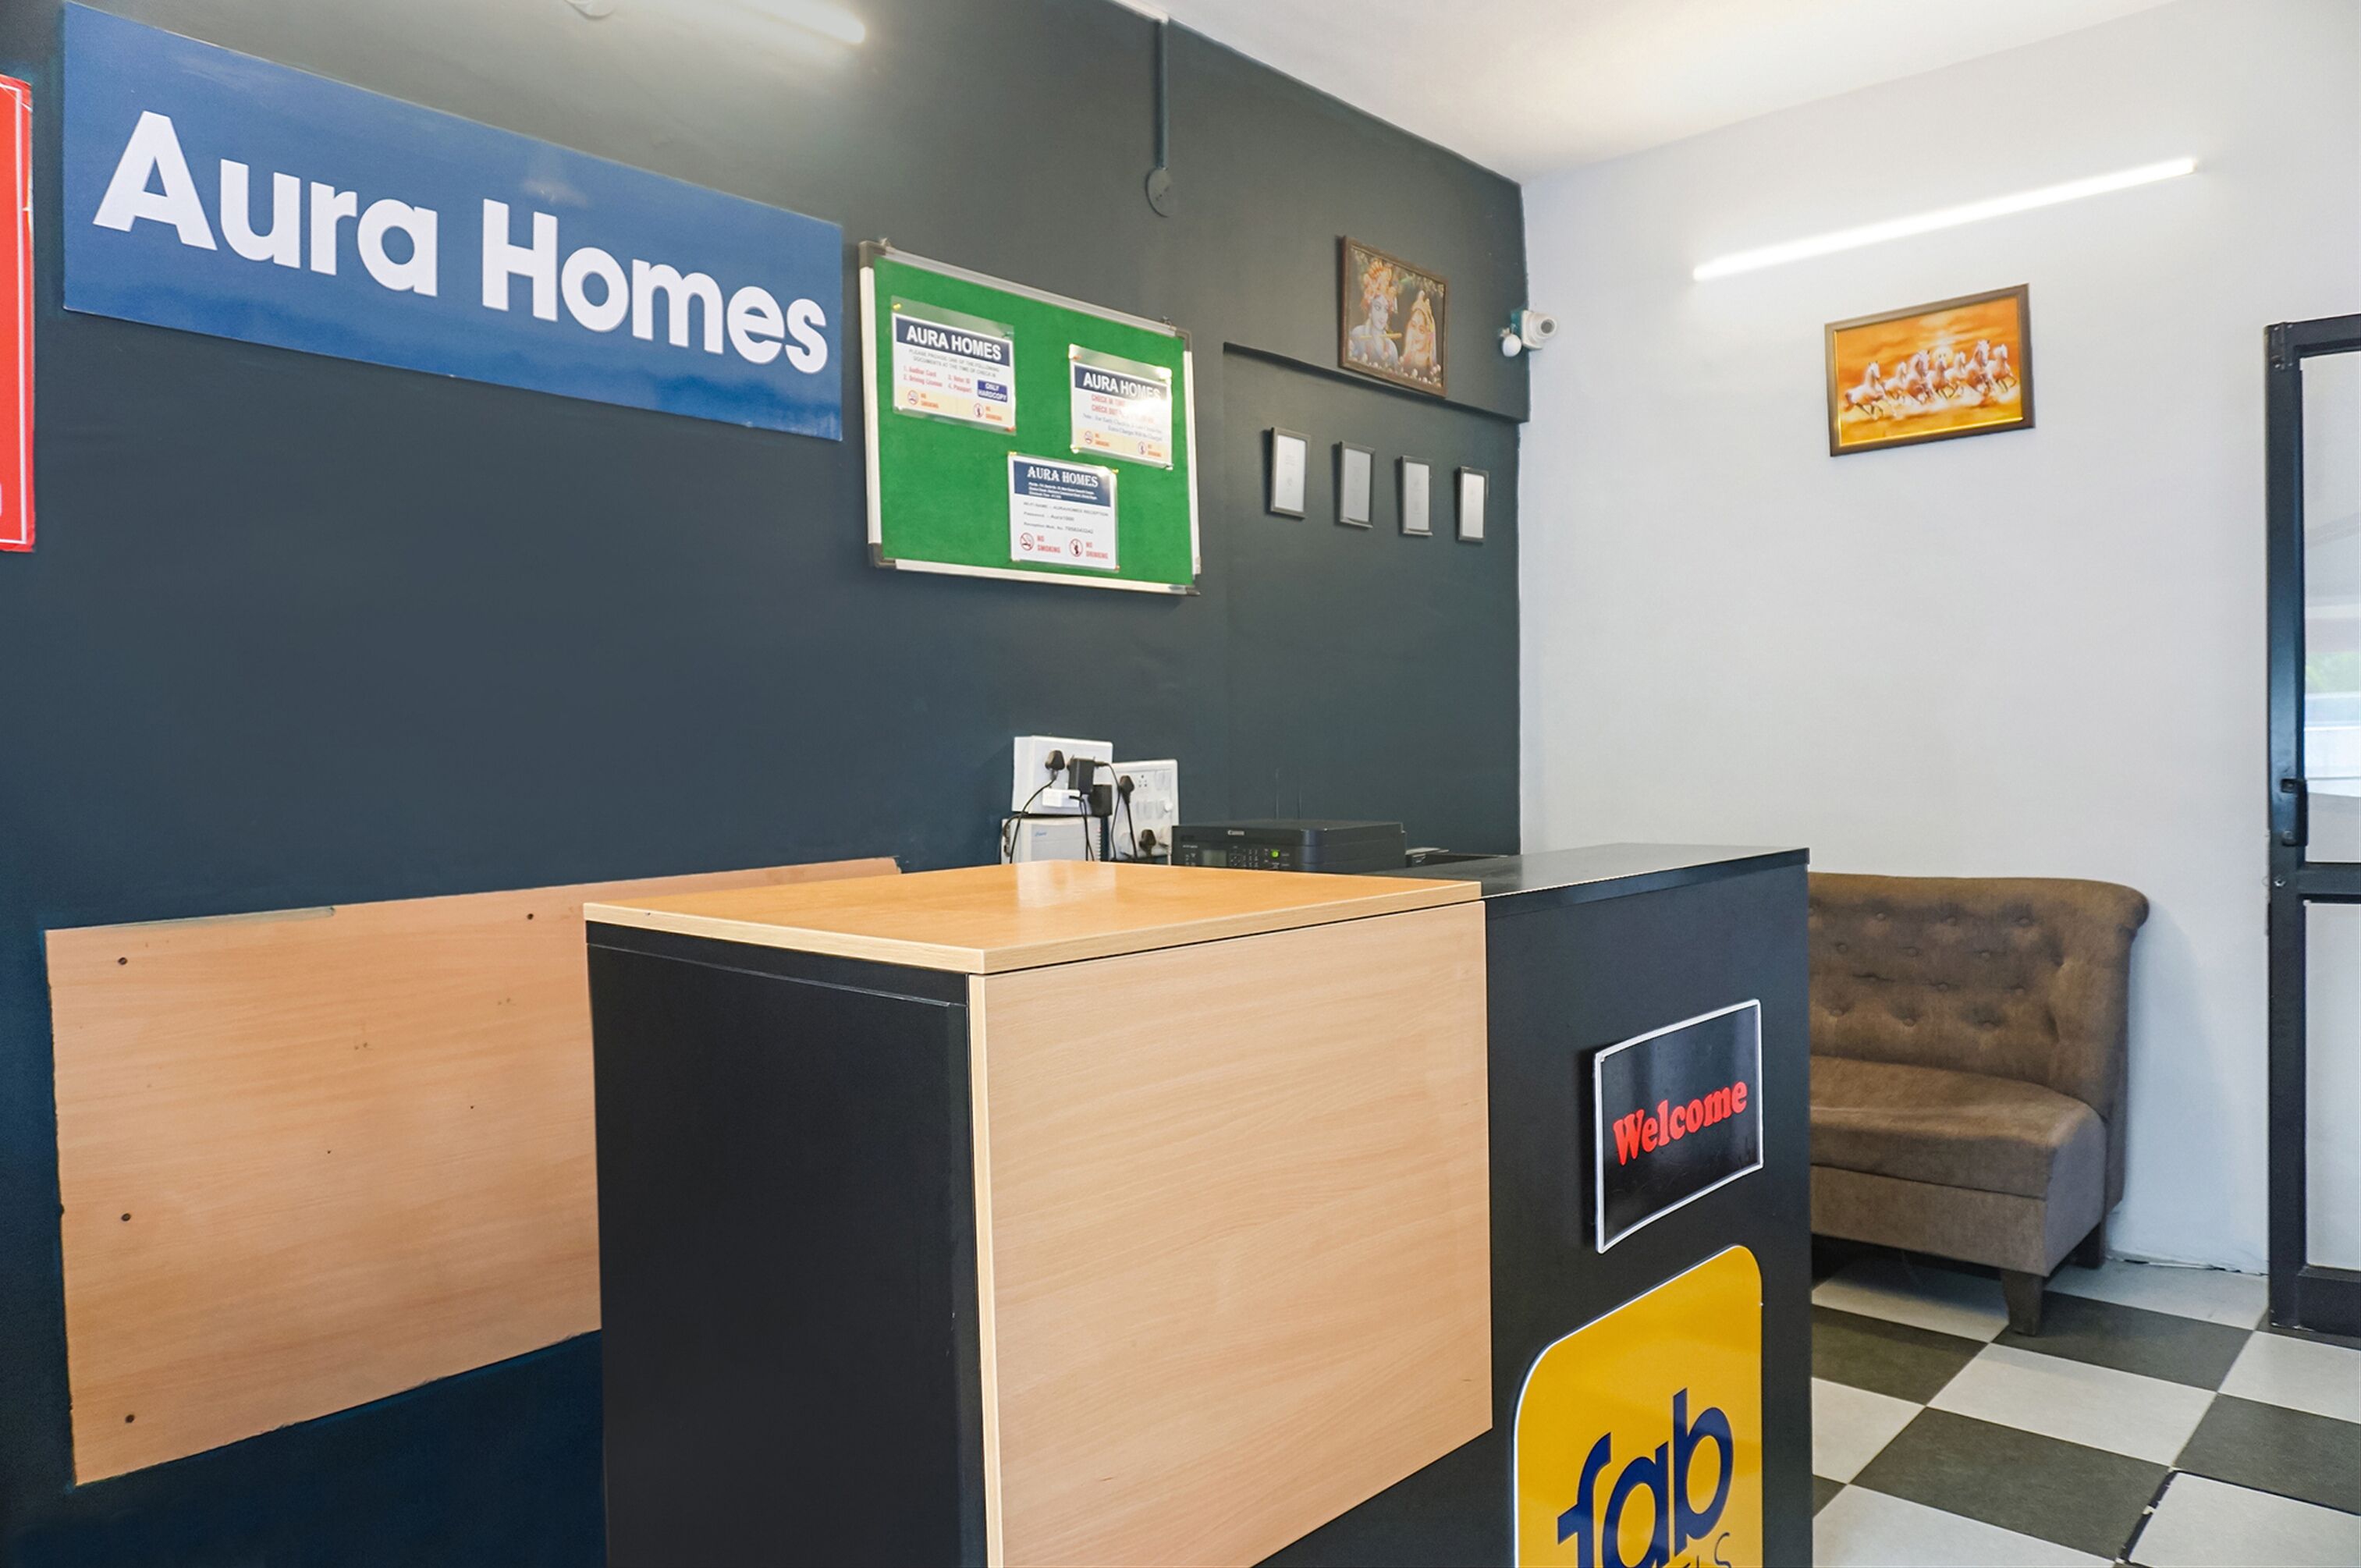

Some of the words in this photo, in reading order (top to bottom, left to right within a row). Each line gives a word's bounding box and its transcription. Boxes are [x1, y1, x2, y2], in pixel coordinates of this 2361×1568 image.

[93, 110, 438, 296] Aura
[483, 199, 829, 374] Homes
[906, 325, 949, 350] AURA
[951, 334, 1002, 361] HOMES
[1083, 372, 1119, 392] AURA
[1120, 380, 1162, 399] HOMES
[1027, 466, 1060, 481] AURA
[1062, 471, 1099, 487] HOMES
[1613, 1080, 1748, 1165] Welcome
[1557, 1387, 1734, 1568] fab
